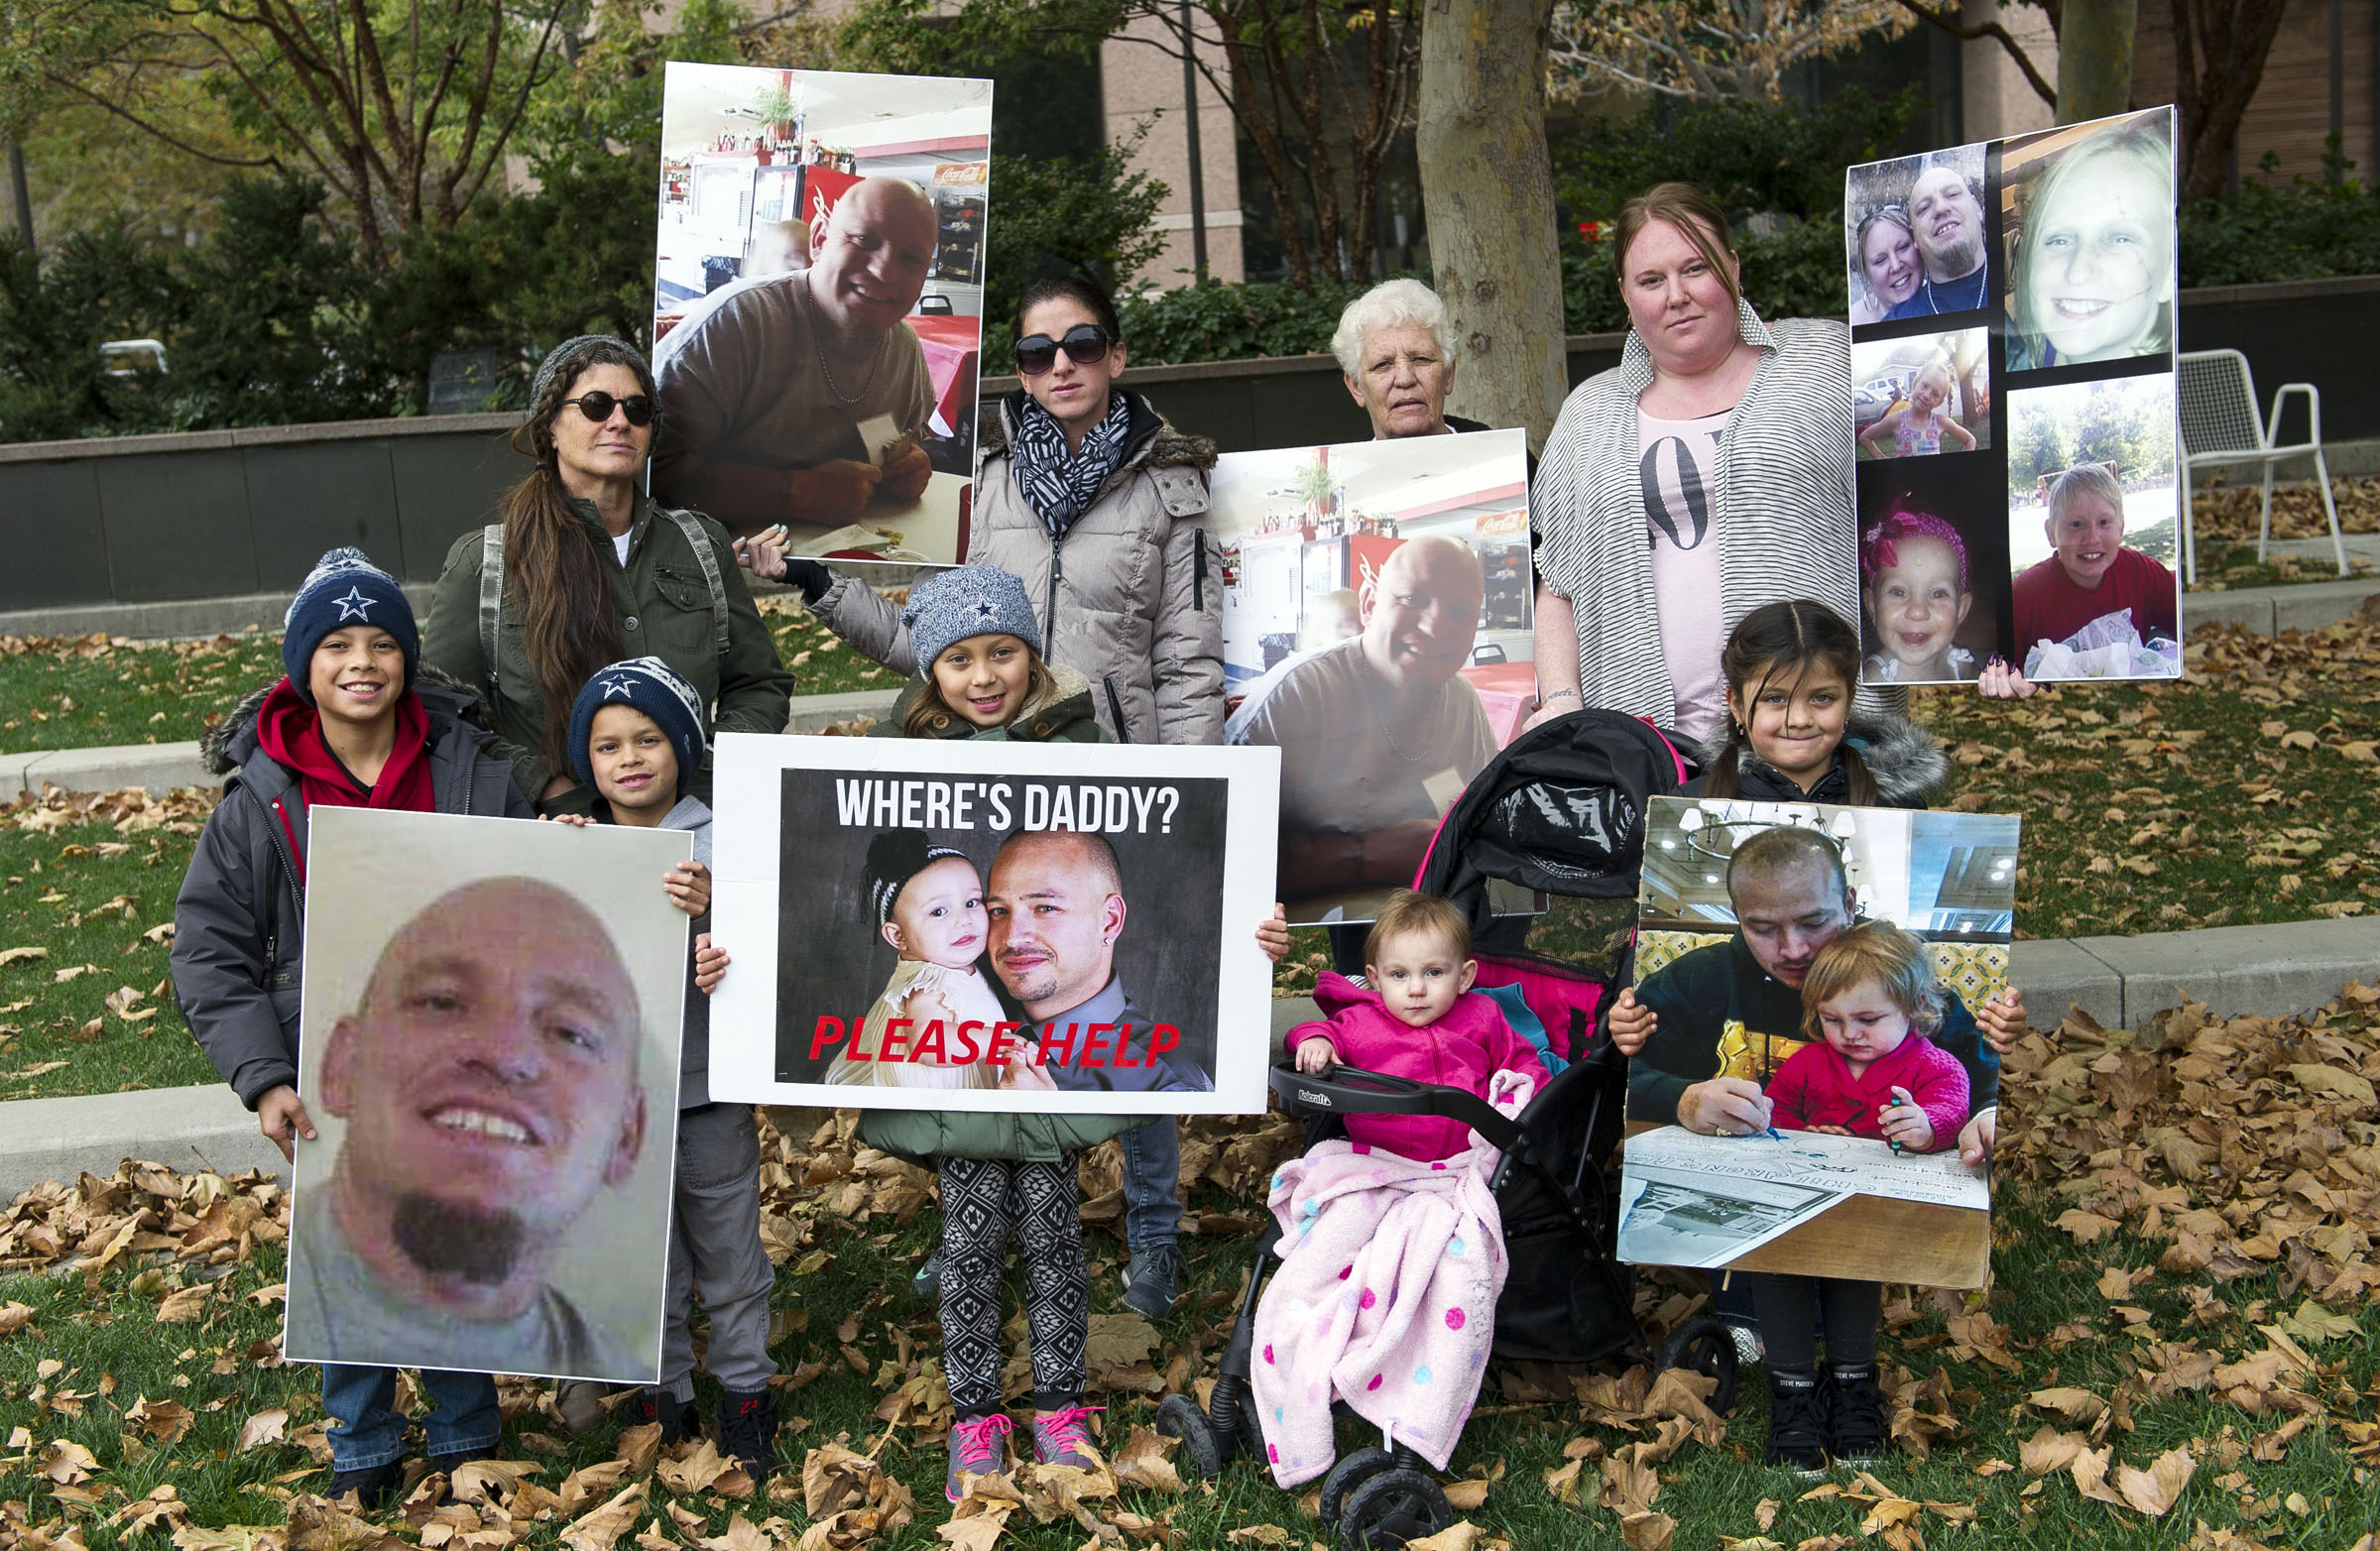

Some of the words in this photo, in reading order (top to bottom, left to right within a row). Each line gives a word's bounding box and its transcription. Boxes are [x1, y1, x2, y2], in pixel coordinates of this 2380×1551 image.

[836, 778, 1012, 831] WHERE'S
[1024, 784, 1179, 834] DADDY?
[809, 1015, 1020, 1066] PLEASE
[1036, 1023, 1180, 1068] HELP
[1298, 1089, 1327, 1106] Kolcraft
